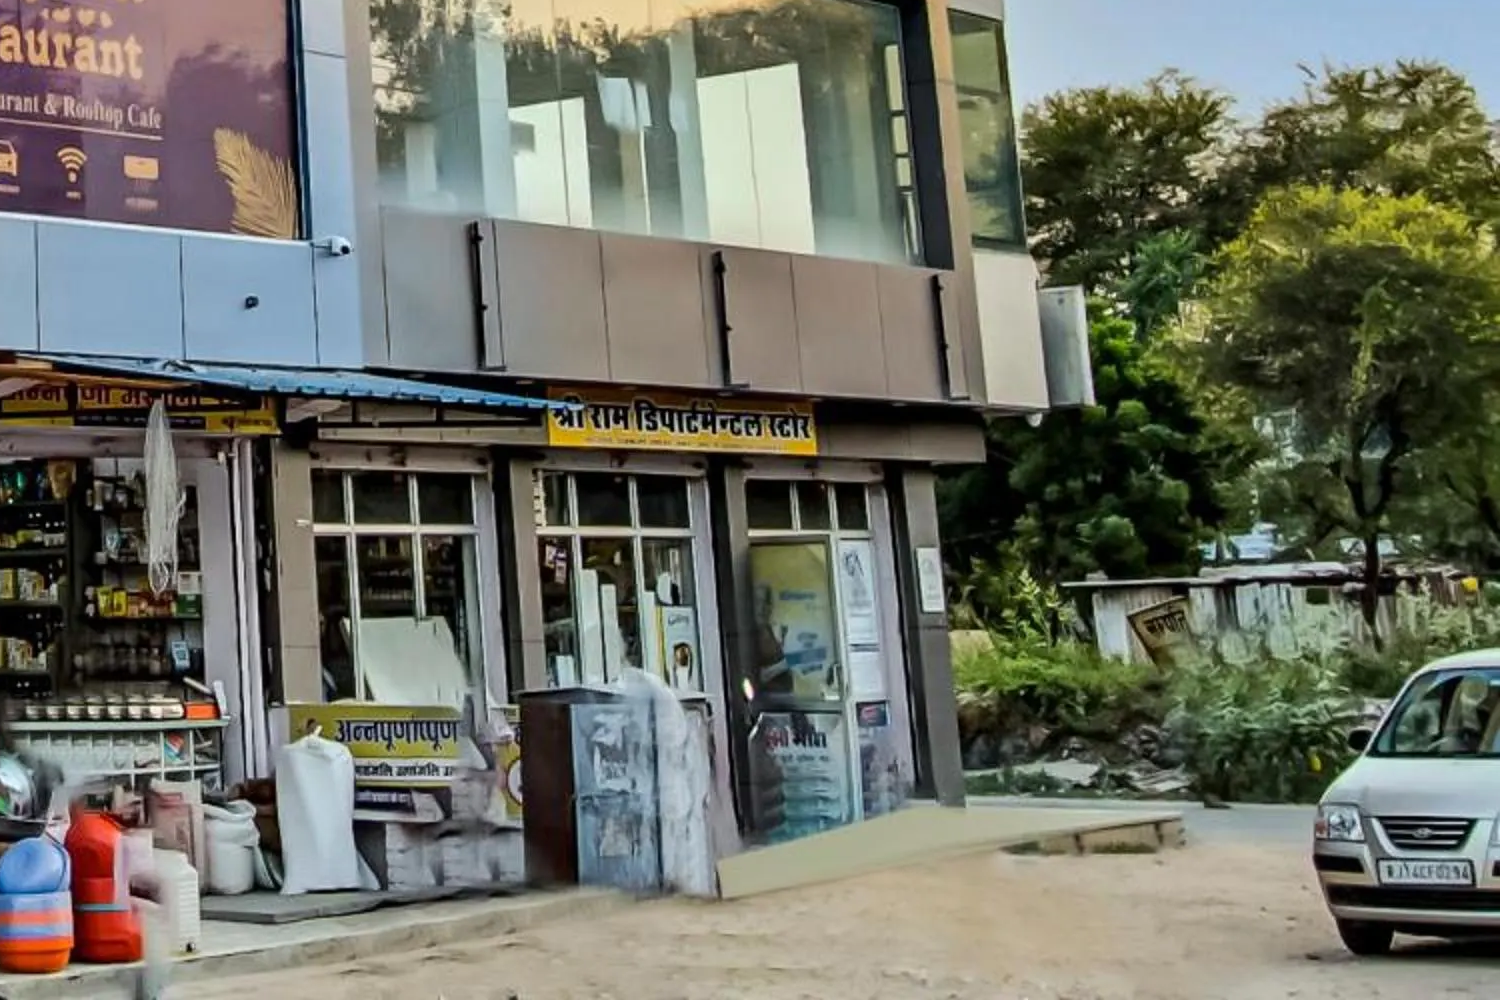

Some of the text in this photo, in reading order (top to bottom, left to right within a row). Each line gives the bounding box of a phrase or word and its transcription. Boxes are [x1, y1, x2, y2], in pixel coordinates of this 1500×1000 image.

[43, 94, 59, 116] &
[63, 97, 124, 128] Rooftop
[127, 106, 163, 130] Cafe
[588, 403, 629, 431] राम
[768, 407, 812, 439] स्टोर
